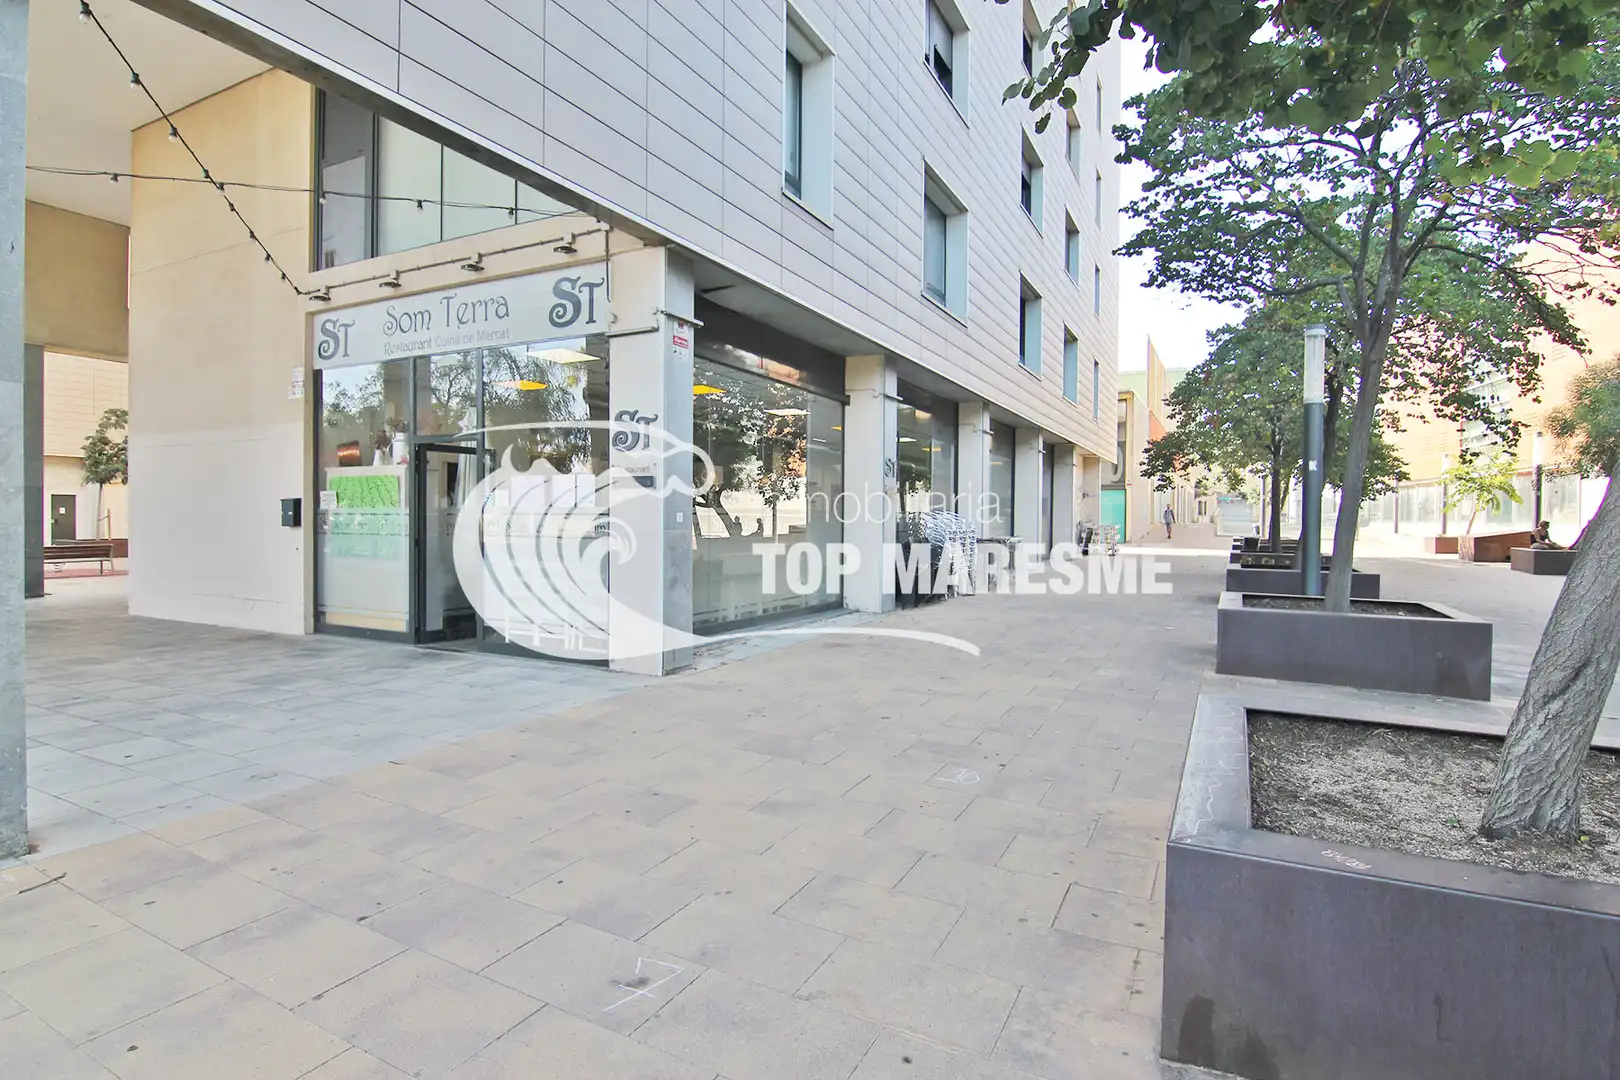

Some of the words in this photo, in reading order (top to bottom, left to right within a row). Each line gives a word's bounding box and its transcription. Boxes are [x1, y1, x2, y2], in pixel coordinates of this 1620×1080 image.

[382, 305, 432, 336] Som
[440, 292, 510, 330] Terra
[548, 275, 605, 329] ST
[317, 318, 356, 361] ST
[383, 337, 433, 357] Restaurant
[463, 332, 475, 344] de
[476, 327, 511, 344] Mercat
[612, 409, 659, 453] ST
